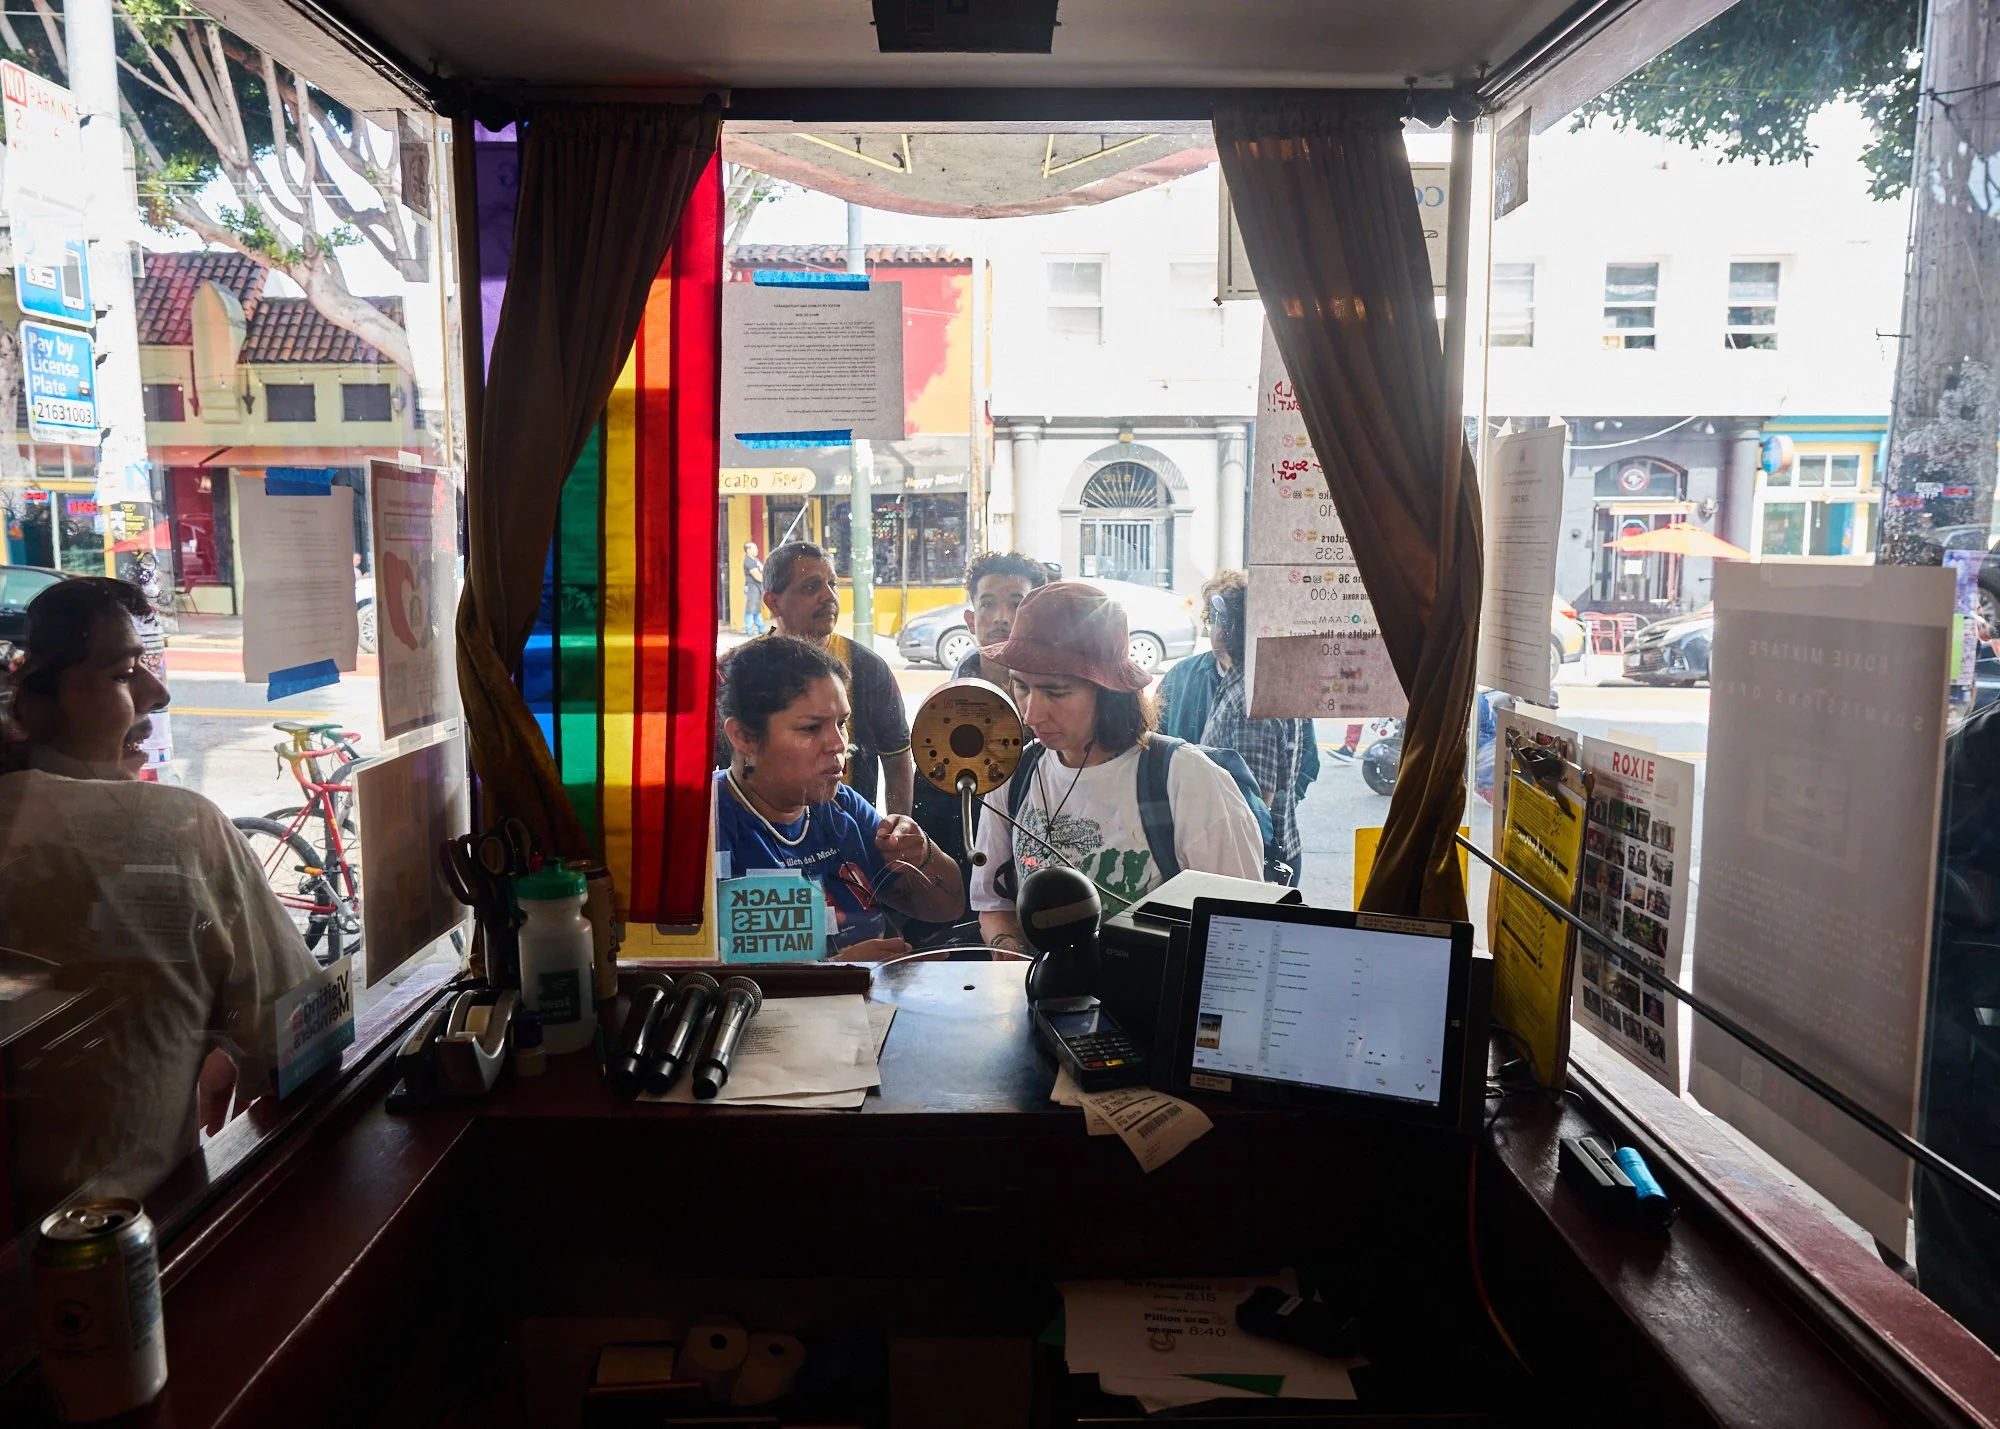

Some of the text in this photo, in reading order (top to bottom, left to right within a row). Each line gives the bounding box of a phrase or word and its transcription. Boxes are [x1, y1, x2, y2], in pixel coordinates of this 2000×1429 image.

[4, 65, 25, 102] NO
[28, 331, 74, 361] Pay by
[30, 354, 80, 378] License
[32, 374, 67, 396] Plate
[37, 402, 92, 424] 21631003
[1612, 751, 1656, 783] ROXIE
[804, 855, 816, 865] del
[1106, 947, 1130, 959] EPSON
[1144, 1312, 1182, 1323] Pillion
[1189, 1326, 1227, 1337] 8:40
